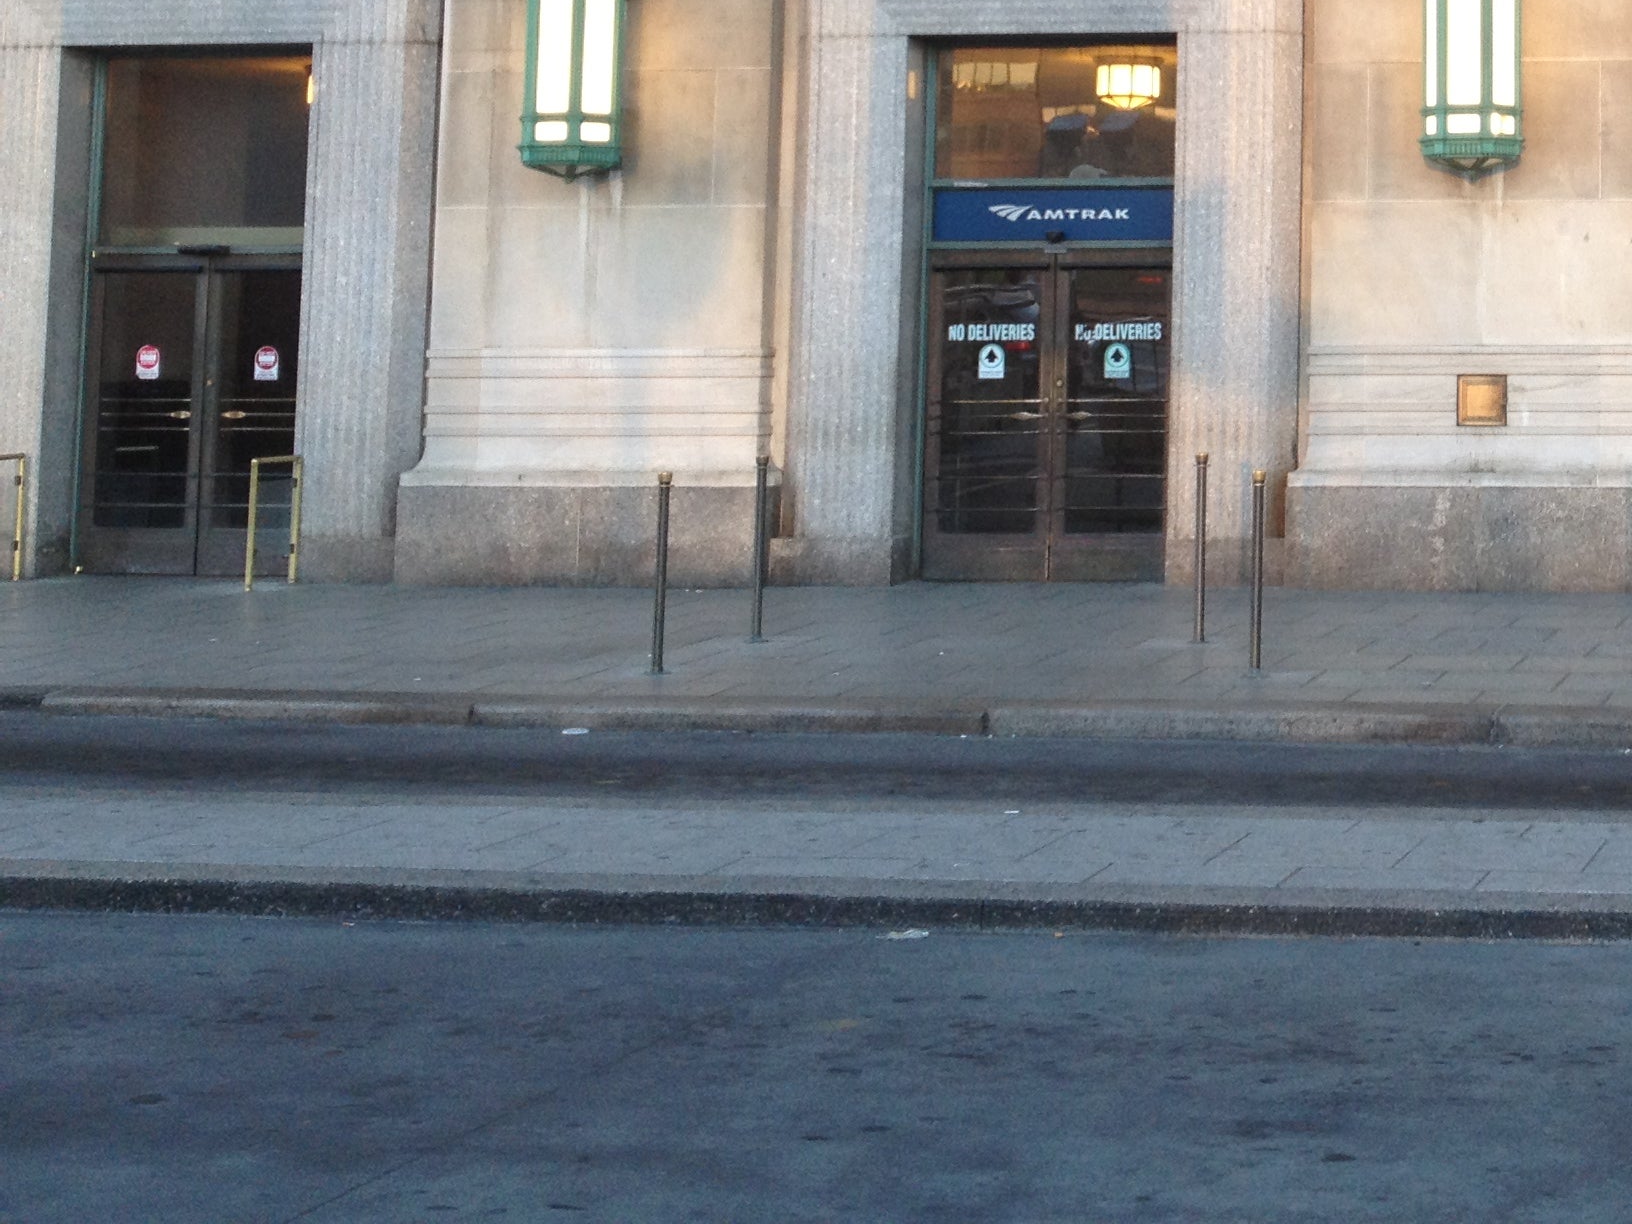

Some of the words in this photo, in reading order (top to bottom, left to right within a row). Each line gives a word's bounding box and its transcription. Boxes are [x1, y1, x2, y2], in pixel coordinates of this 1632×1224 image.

[1026, 208, 1130, 221] AMTRAK
[948, 324, 965, 342] NO
[968, 323, 1036, 342] DELIVERIES
[1094, 322, 1162, 341] DELIVERIES
